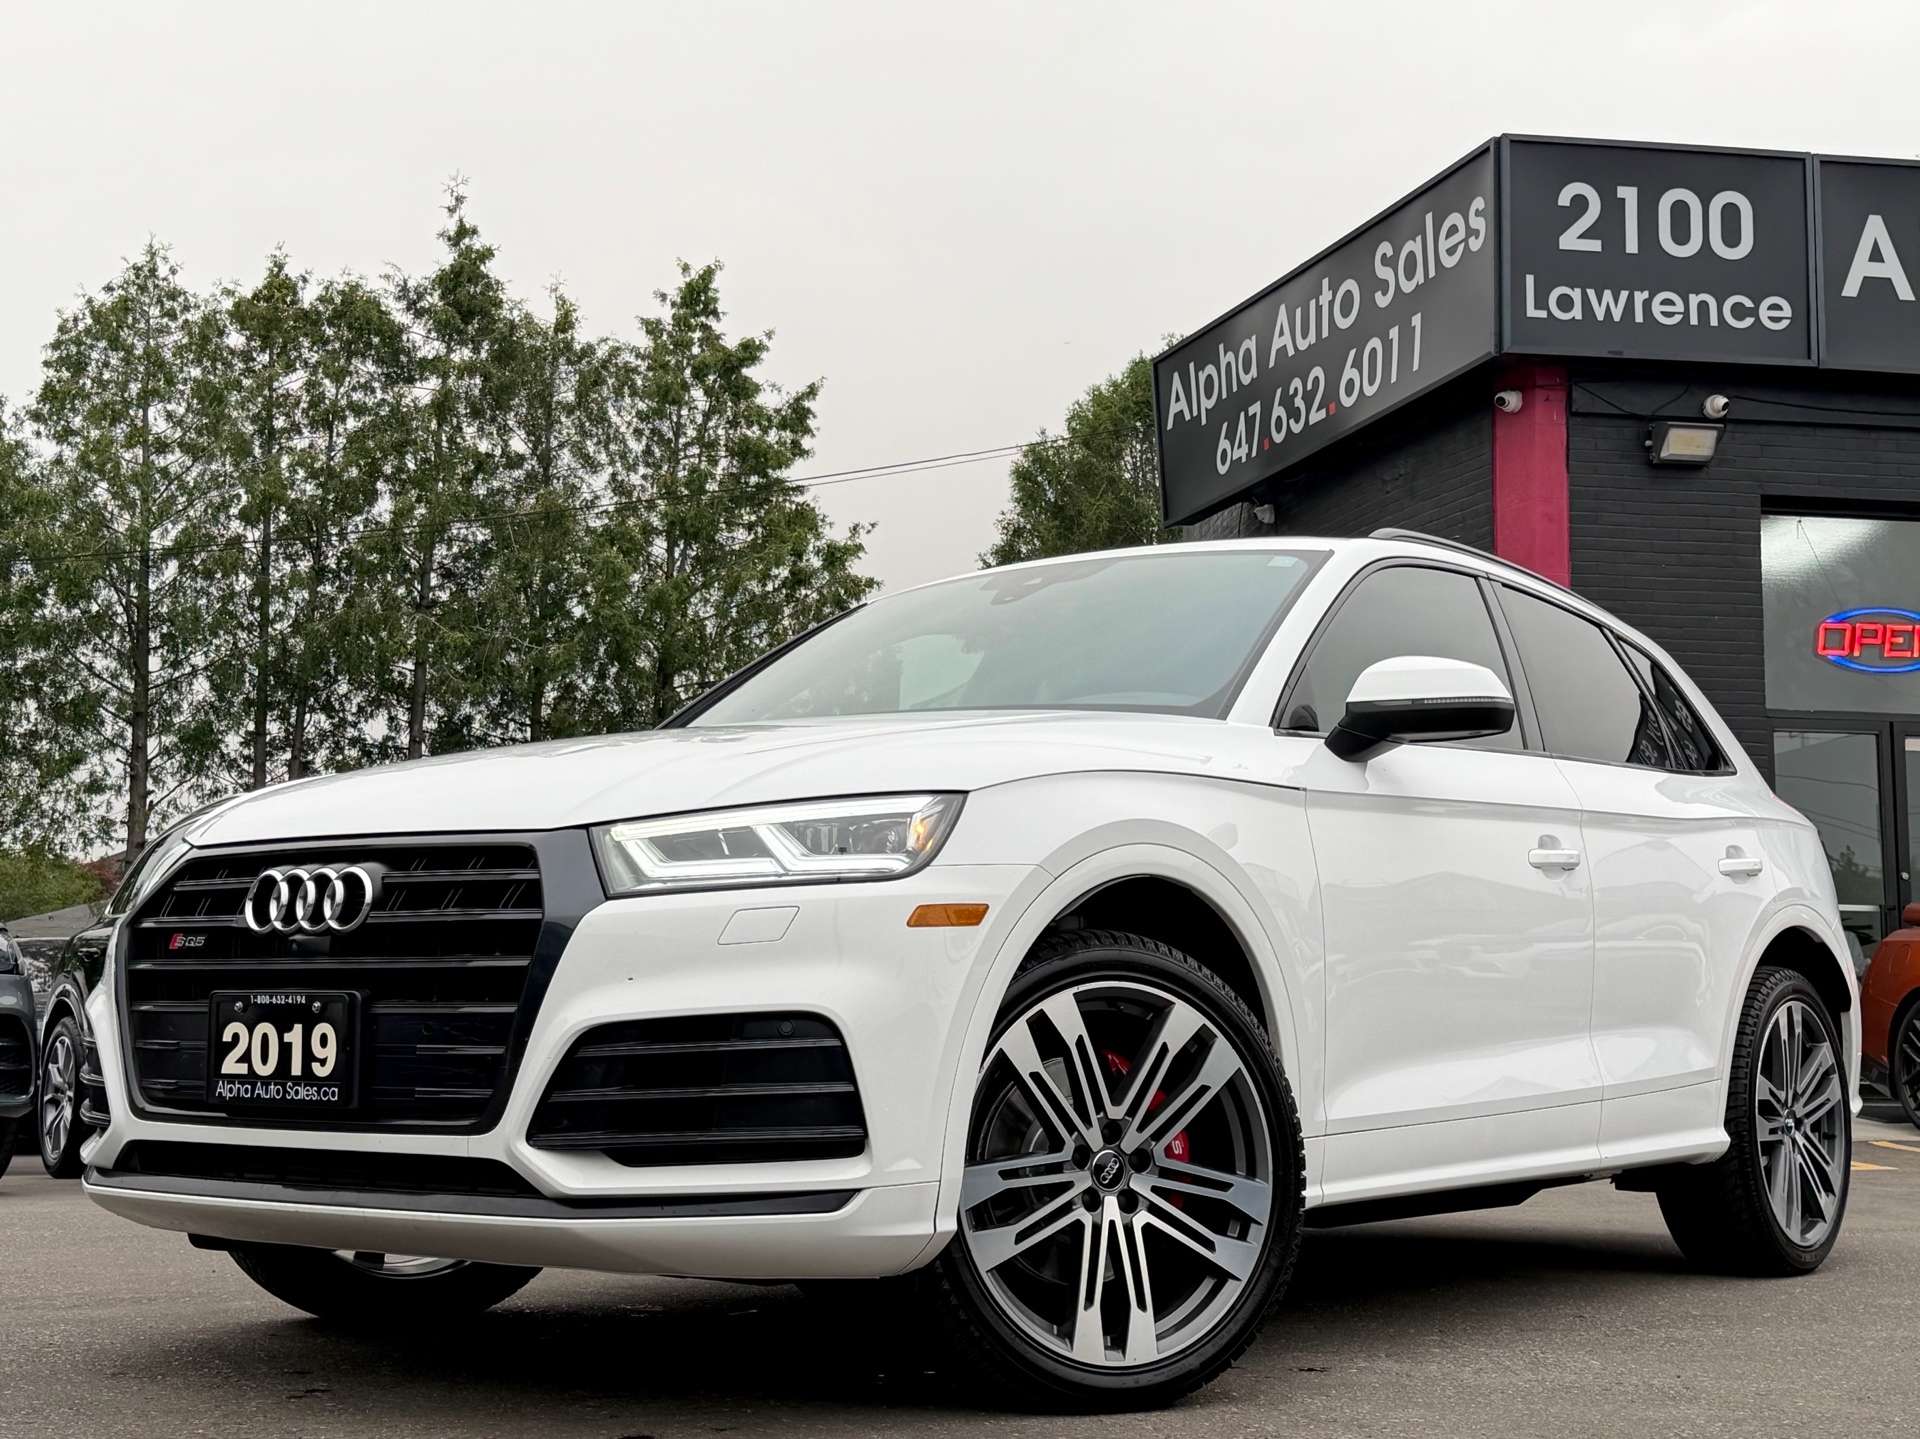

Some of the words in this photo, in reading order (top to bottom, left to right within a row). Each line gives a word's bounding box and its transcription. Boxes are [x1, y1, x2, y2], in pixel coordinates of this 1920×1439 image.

[1557, 181, 1754, 260] 2100
[1840, 214, 1916, 301] A
[1166, 334, 1258, 431] Alpha
[1268, 276, 1361, 369] Auto
[1373, 195, 1487, 309] Sales
[1525, 273, 1793, 331] Lawrence
[1215, 312, 1422, 476] 647.632.6011
[1817, 622, 1920, 658] OPE
[170, 934, 206, 948] SQ5
[220, 1021, 338, 1078] 2019
[215, 1080, 252, 1101] Alpha
[253, 1081, 283, 1100] Auto
[286, 1082, 339, 1102] Sales.ca
